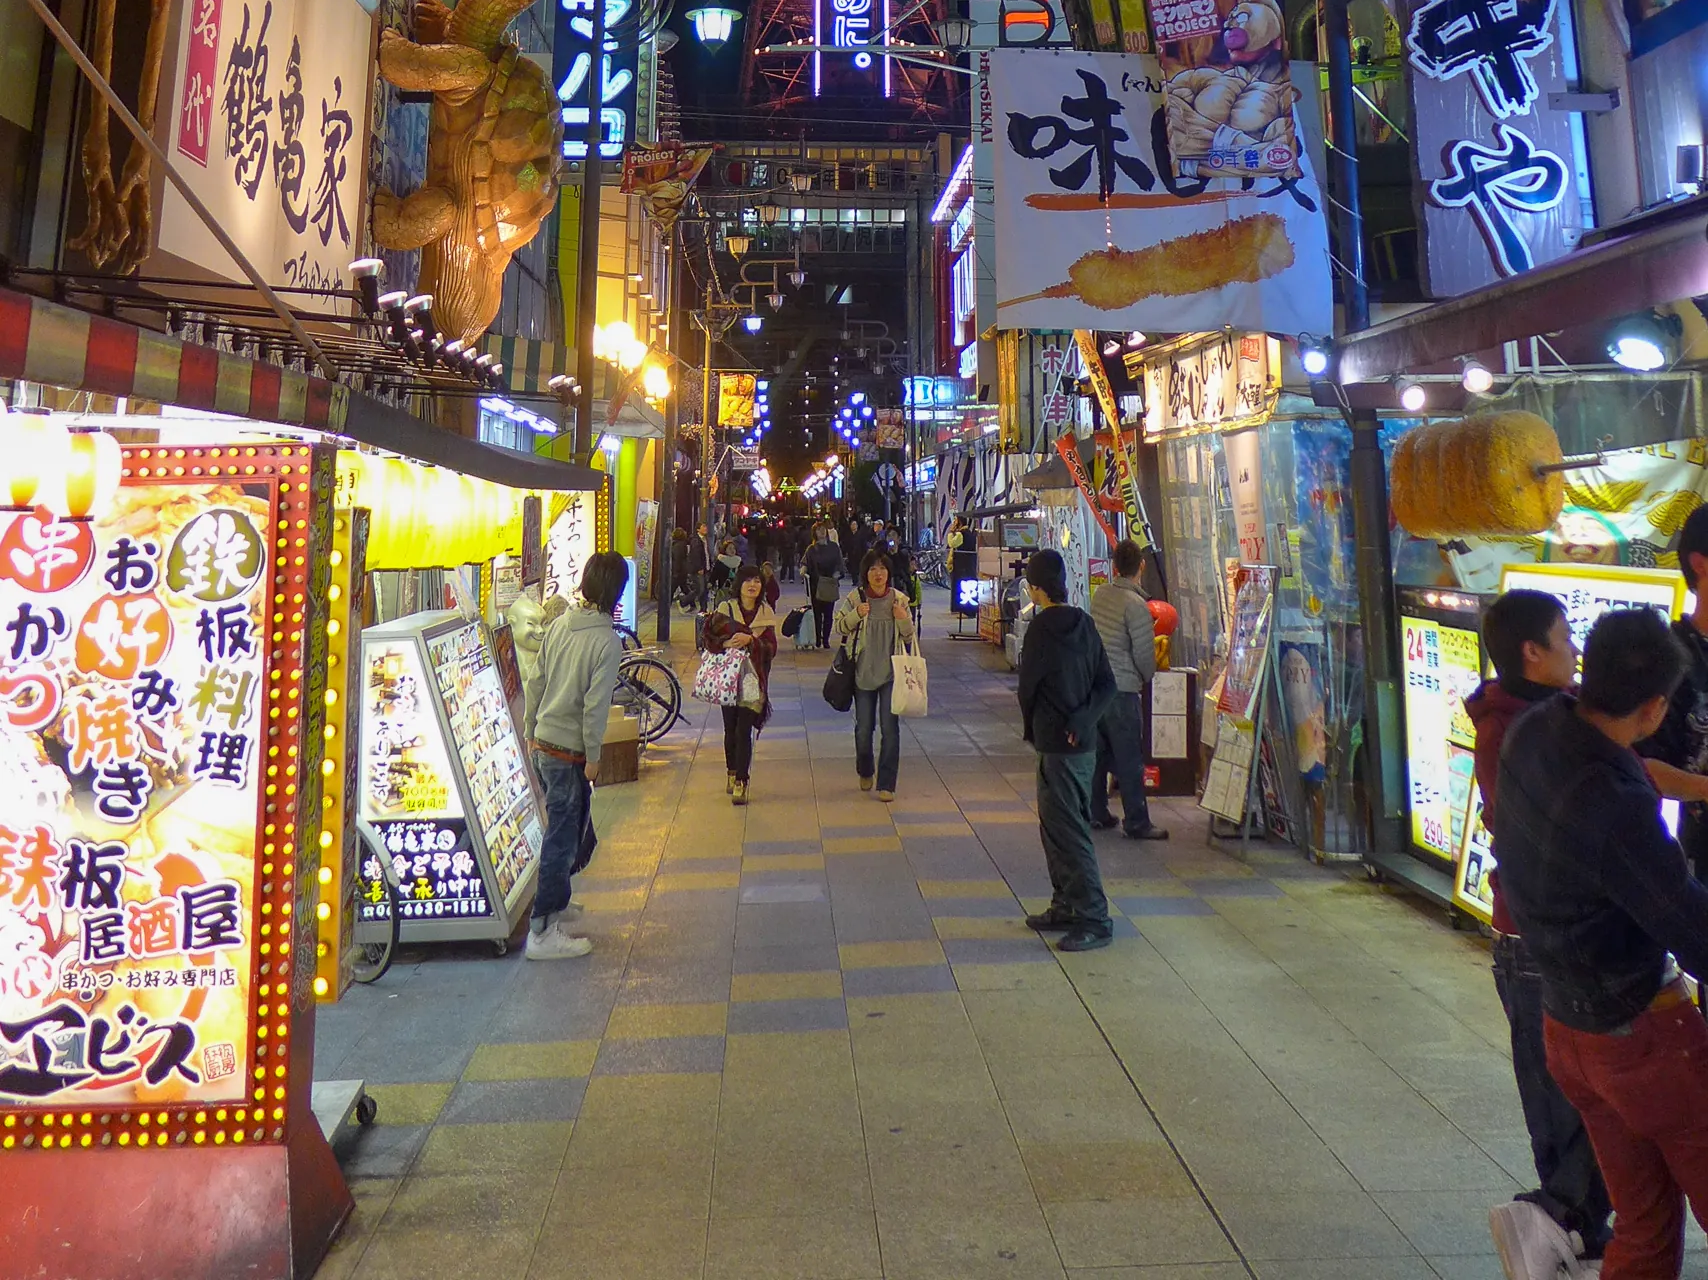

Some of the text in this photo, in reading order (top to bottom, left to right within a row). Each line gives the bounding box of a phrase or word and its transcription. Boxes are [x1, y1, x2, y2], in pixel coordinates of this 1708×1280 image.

[1124, 31, 1148, 52] 300
[1156, 13, 1218, 37] PROJECT
[221, 0, 354, 249] 鶴亀家
[630, 150, 675, 164] PROJECT
[0, 512, 82, 727] 串かつ
[1407, 628, 1423, 663] 24
[180, 512, 254, 784] 鉄板料理
[68, 536, 178, 818] お好み焼き
[364, 878, 481, 903] 喜で承り中!!
[83, 884, 241, 961] 居酒屋
[62, 967, 236, 990] 串かつ・お好み専門店
[0, 1003, 200, 1097] エビス
